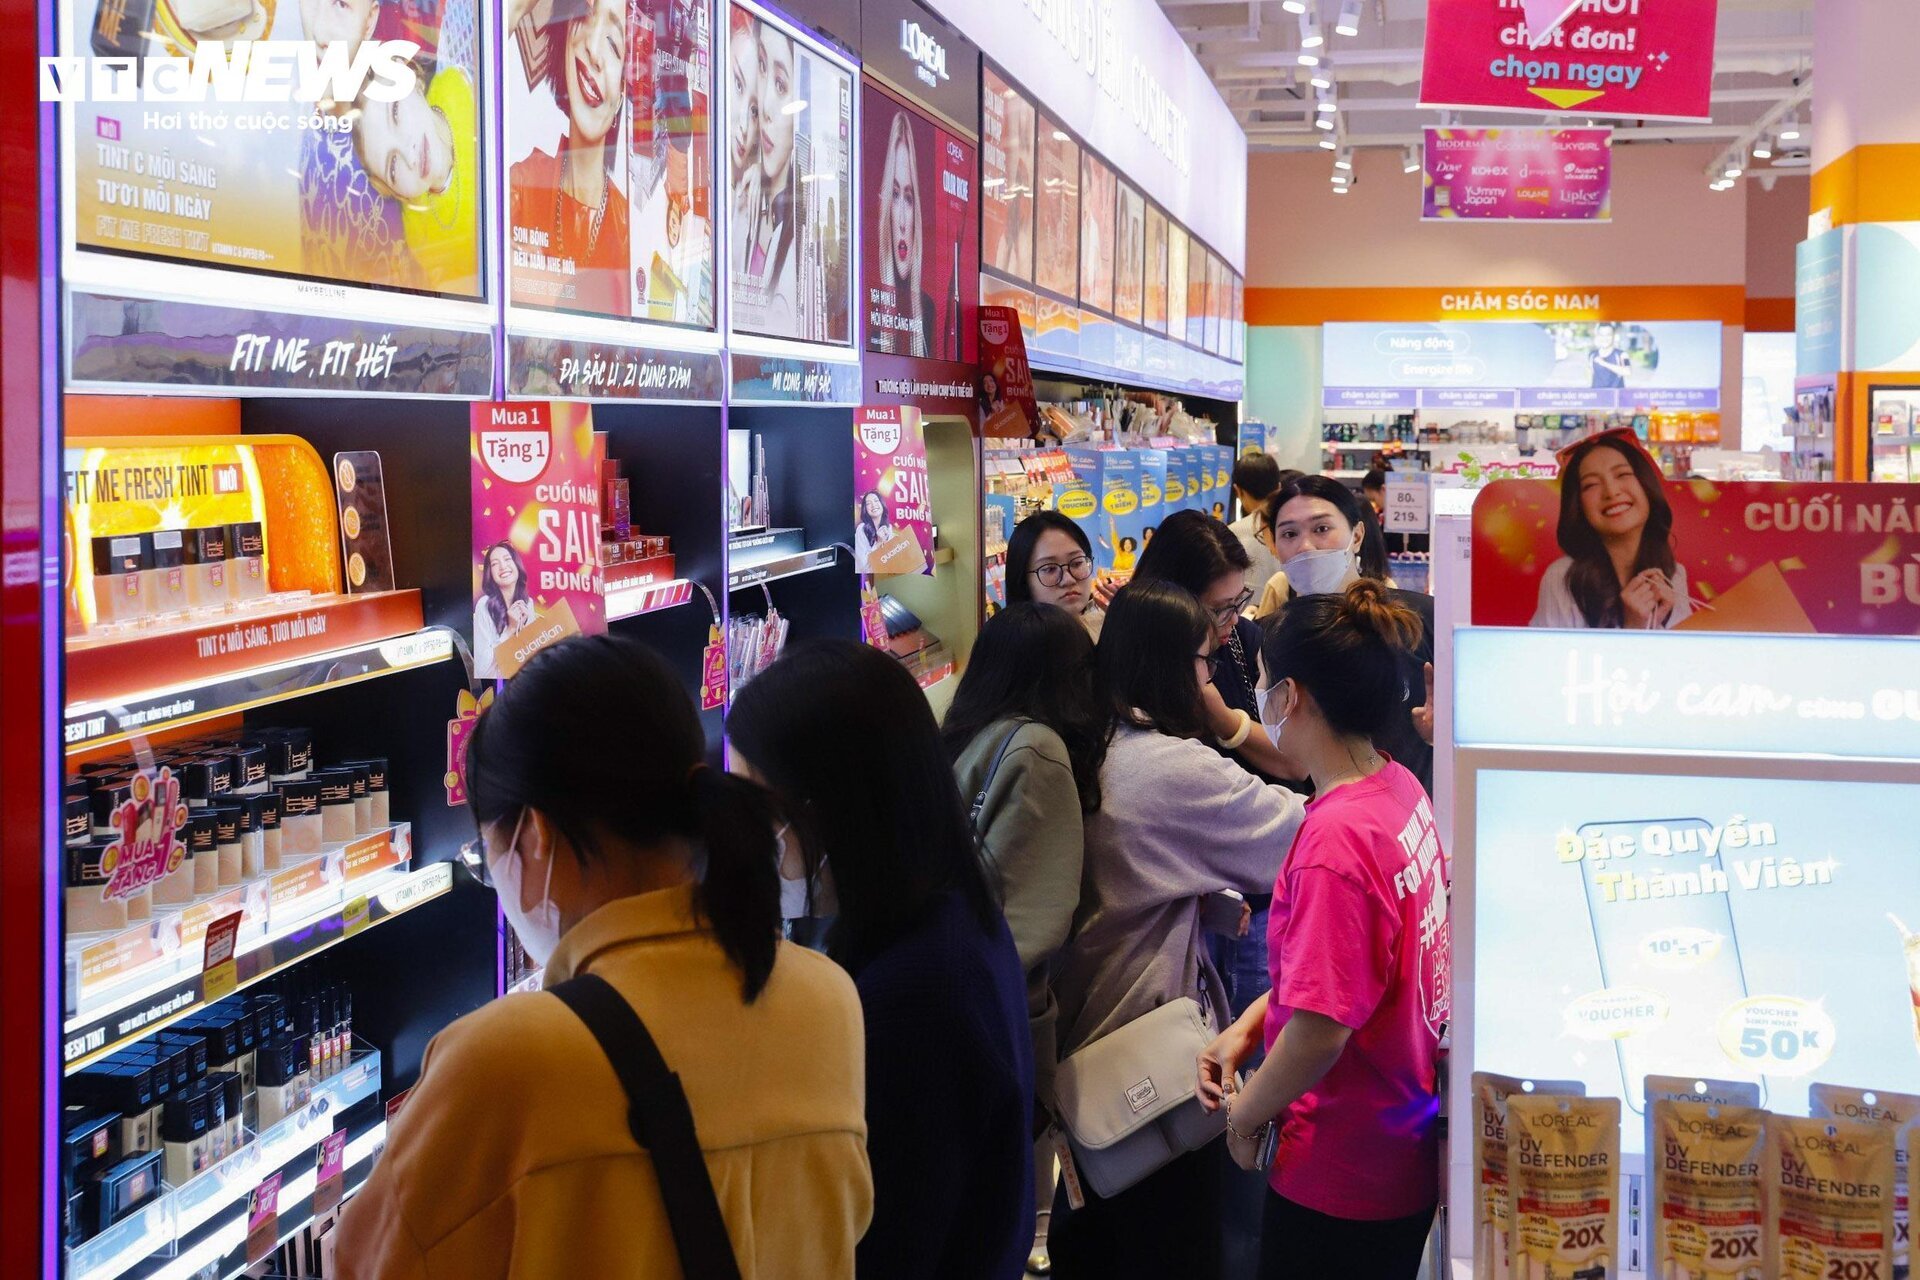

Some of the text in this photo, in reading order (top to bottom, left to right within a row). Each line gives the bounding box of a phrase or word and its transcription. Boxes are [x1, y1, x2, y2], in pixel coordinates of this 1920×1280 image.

[1570, 26, 1637, 51] đơn!
[901, 19, 950, 81] L'ORÉAL
[1489, 54, 1643, 89] chọn ngay
[96, 143, 217, 189] TINT C MỖI SÁNG
[96, 179, 212, 221] TƯƠI MỖI NGÀY
[1464, 195, 1497, 205] Japan
[513, 225, 549, 248] SON BÓNG
[1440, 290, 1600, 311] CHĂM SÓC NAM
[230, 334, 263, 372] FIT
[320, 340, 354, 376] FIT
[354, 332, 398, 379] HẾT
[491, 407, 541, 426] Mua 1
[866, 408, 896, 421] Mua 1
[863, 427, 899, 444] Tặng 1
[486, 438, 546, 464] Tặng 1
[892, 453, 917, 468] CUỐI
[64, 464, 238, 504] FIT ME FRESH TINT MỚI
[535, 479, 576, 504] CUỐI
[895, 505, 926, 522] BÙNG
[1744, 492, 1920, 533] CUỐI NĂ
[880, 538, 911, 564] guardian
[540, 566, 591, 593] BÙNG
[196, 635, 218, 659] TINT
[219, 634, 226, 654] C
[226, 623, 244, 652] MỖI
[271, 622, 289, 644] TƯƠI
[290, 612, 306, 640] MỖI
[306, 610, 327, 637] NGÀY
[514, 621, 564, 662] guardian
[1561, 648, 1661, 727] Hội
[87, 716, 106, 738] TINT
[335, 783, 350, 800] ME
[353, 779, 365, 794] ME
[369, 772, 384, 789] ME
[286, 796, 301, 812] FIT
[262, 807, 277, 825] ME
[194, 829, 212, 846] ME
[217, 822, 236, 840] ME
[1397, 810, 1424, 859] THANK
[1556, 813, 1777, 871] Đặc Quyền
[1394, 859, 1422, 900] FOR
[1595, 857, 1832, 903] Thành Viên
[1577, 1004, 1656, 1022] VOUCHER
[1745, 1007, 1799, 1018] VOUCHER
[85, 1026, 106, 1052] TINT
[1739, 1027, 1820, 1061] 50K
[1484, 1112, 1506, 1124] UV
[1532, 1113, 1598, 1129] L'ORÉAL
[1519, 1138, 1543, 1153] UV
[1665, 1142, 1689, 1159] UV
[1519, 1152, 1609, 1169] DEFENDER
[1665, 1156, 1759, 1177] DEFENDER
[1781, 1157, 1806, 1174] UV
[1781, 1172, 1881, 1198] DEFENDER
[1562, 1224, 1606, 1250] 20X
[1710, 1236, 1759, 1260] 20X
[1828, 1259, 1881, 1280] 20X
